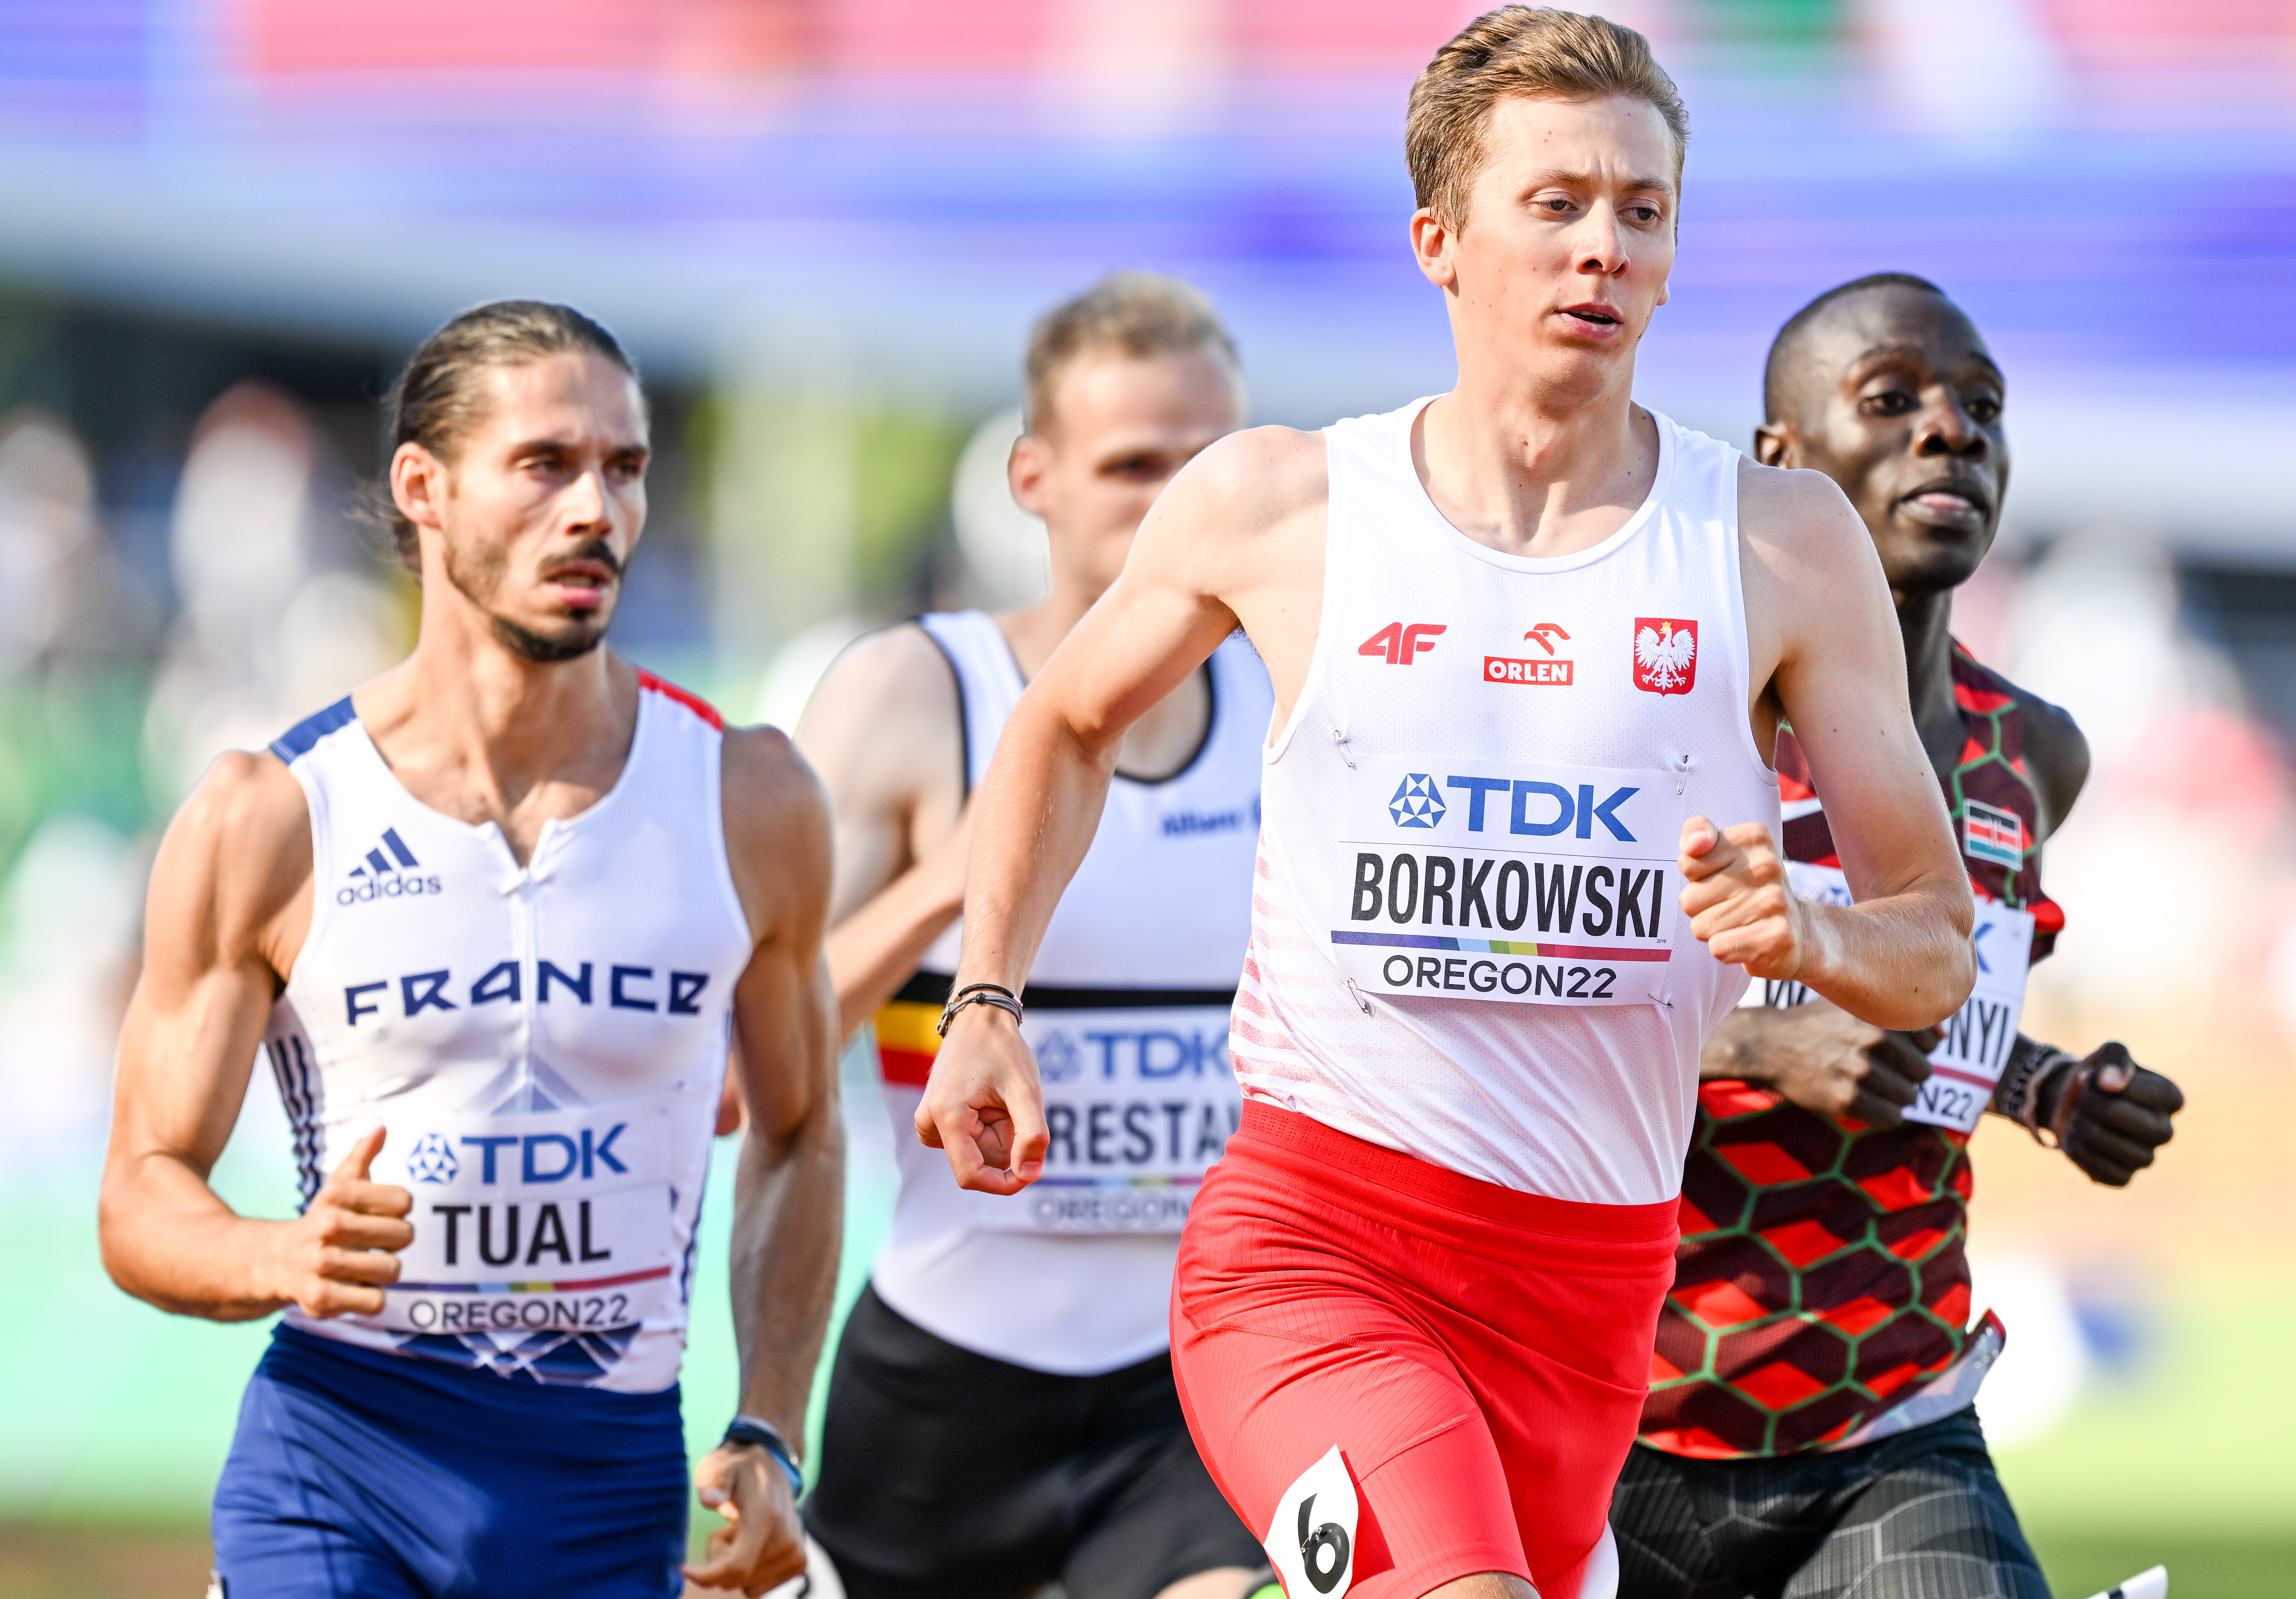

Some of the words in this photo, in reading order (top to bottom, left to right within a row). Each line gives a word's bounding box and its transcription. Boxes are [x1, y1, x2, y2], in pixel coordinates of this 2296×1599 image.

[1358, 622, 1447, 665] 4F
[1488, 661, 1567, 682] ORLEN
[1447, 775, 1640, 842] TDK
[337, 873, 442, 905] adidas
[1351, 852, 1664, 938] BORKOWSKI
[344, 960, 710, 1026] FRANCE
[1383, 955, 1616, 998] OREGON22
[1085, 1031, 1229, 1078] TDK
[461, 1123, 629, 1185] TDK
[1047, 1102, 1241, 1163] RESTA
[432, 1201, 612, 1267] TUAL
[409, 1294, 629, 1330] OREGON22
[1298, 1492, 1350, 1594] 6
